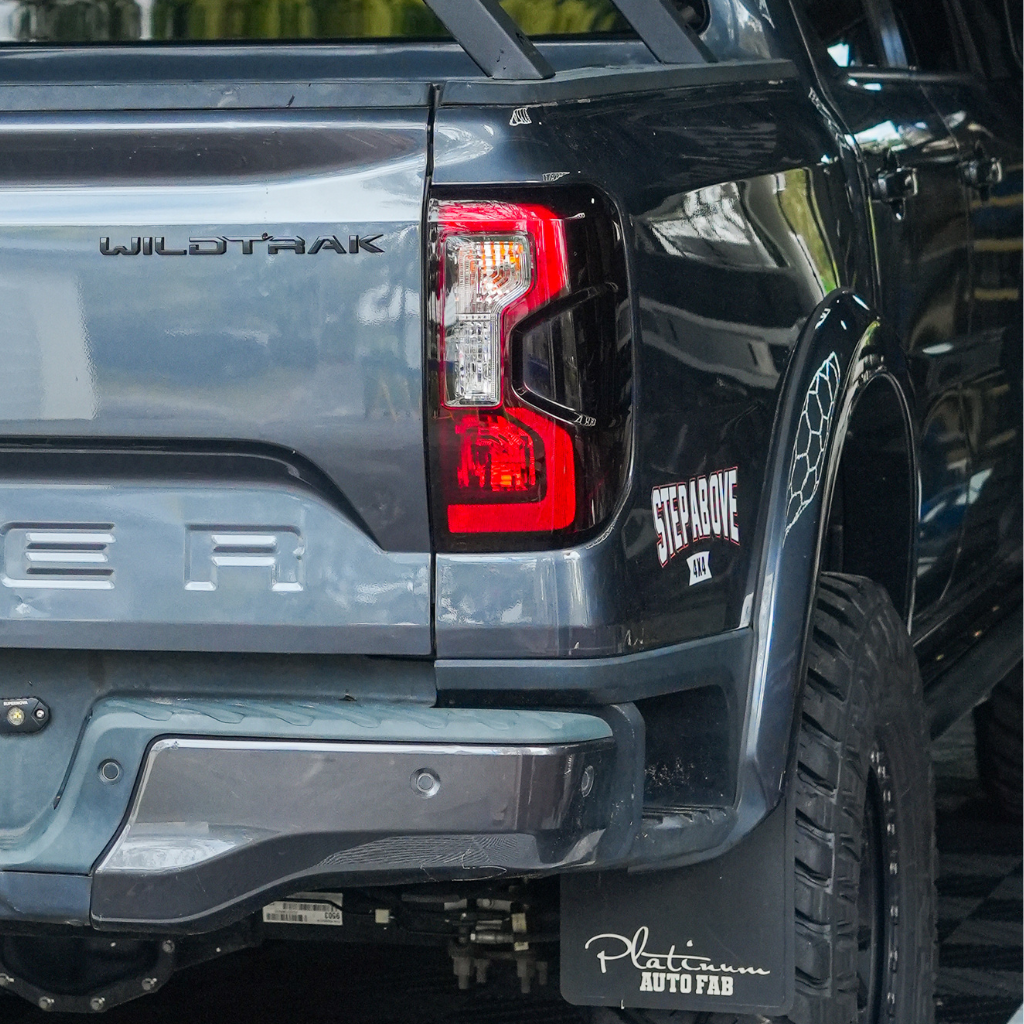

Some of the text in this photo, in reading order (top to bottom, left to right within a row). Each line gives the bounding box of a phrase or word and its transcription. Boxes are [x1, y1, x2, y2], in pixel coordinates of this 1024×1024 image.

[99, 232, 385, 256] WILDTRAK
[585, 926, 770, 975] Platinum
[639, 972, 734, 996] AUTO FAB
